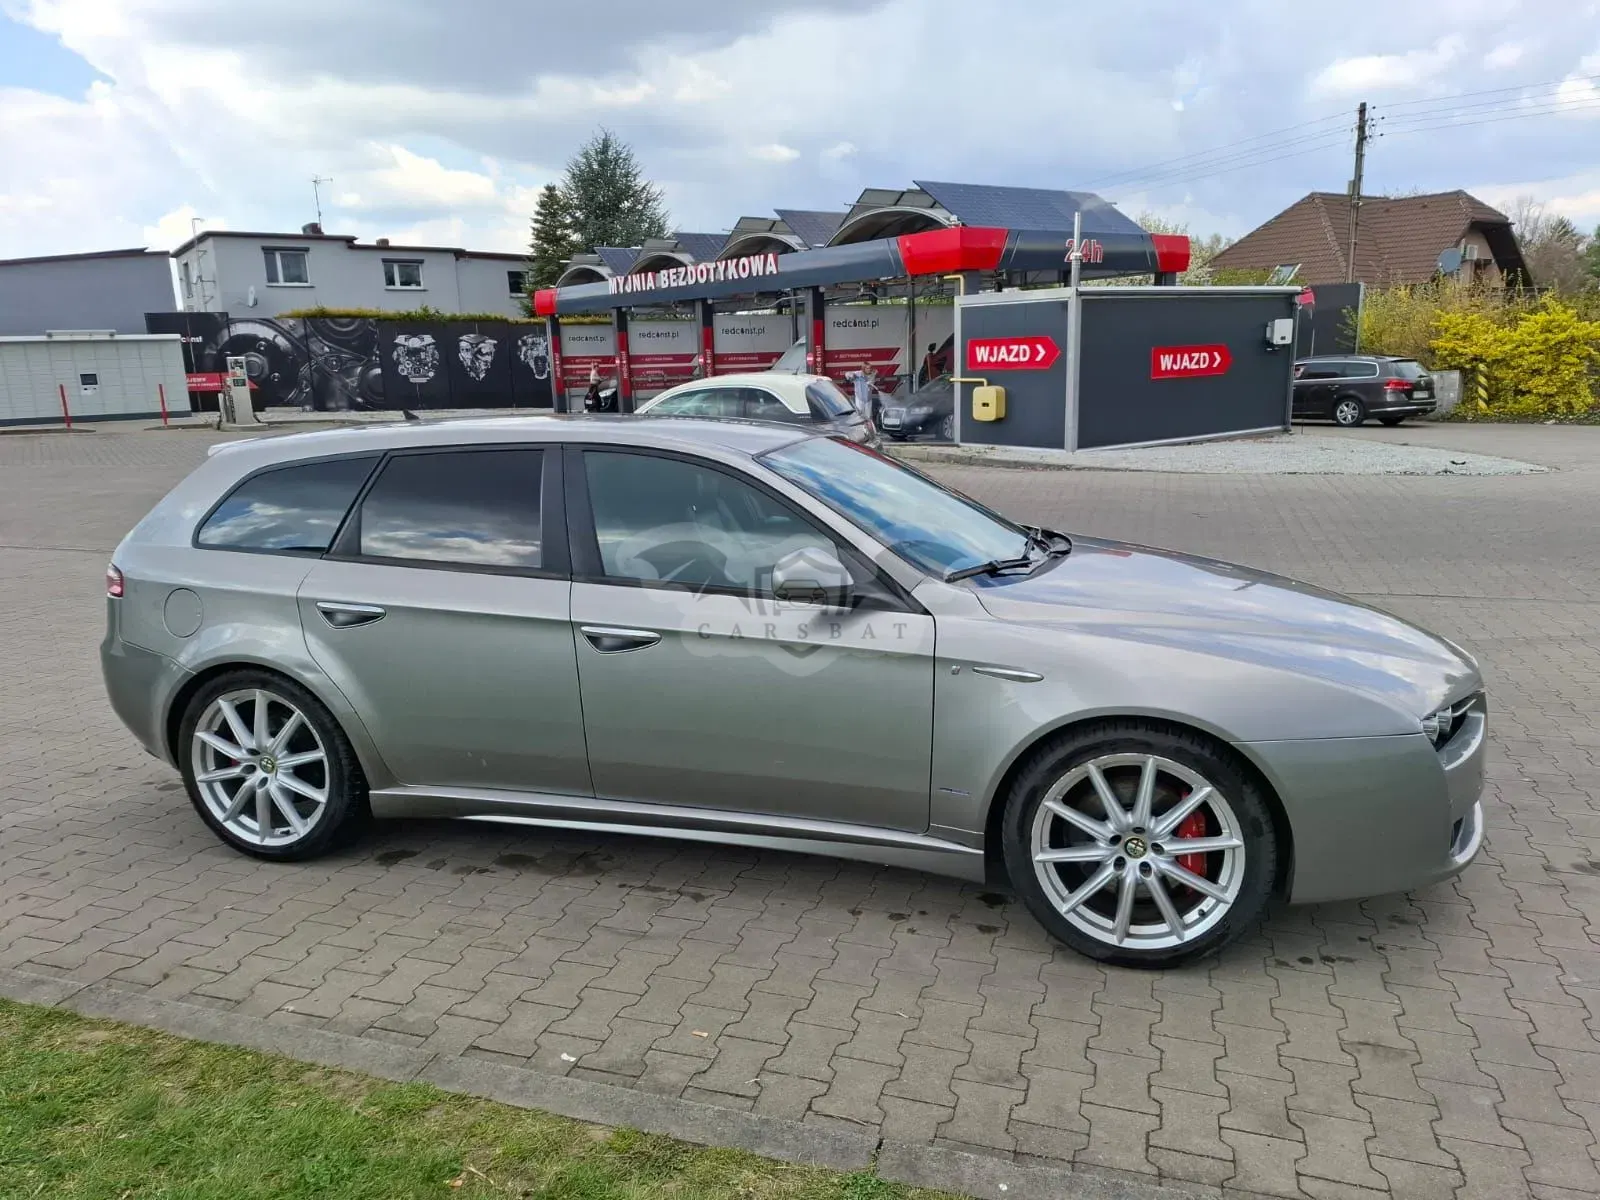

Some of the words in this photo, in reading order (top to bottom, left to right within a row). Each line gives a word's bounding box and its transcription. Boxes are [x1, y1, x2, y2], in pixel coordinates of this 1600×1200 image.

[1064, 239, 1104, 263] 24h
[608, 271, 656, 295] MYJNIA
[660, 252, 778, 290] BEZDOTYKOWA
[975, 344, 1030, 362] WJAZD
[1160, 352, 1210, 371] WJAZD
